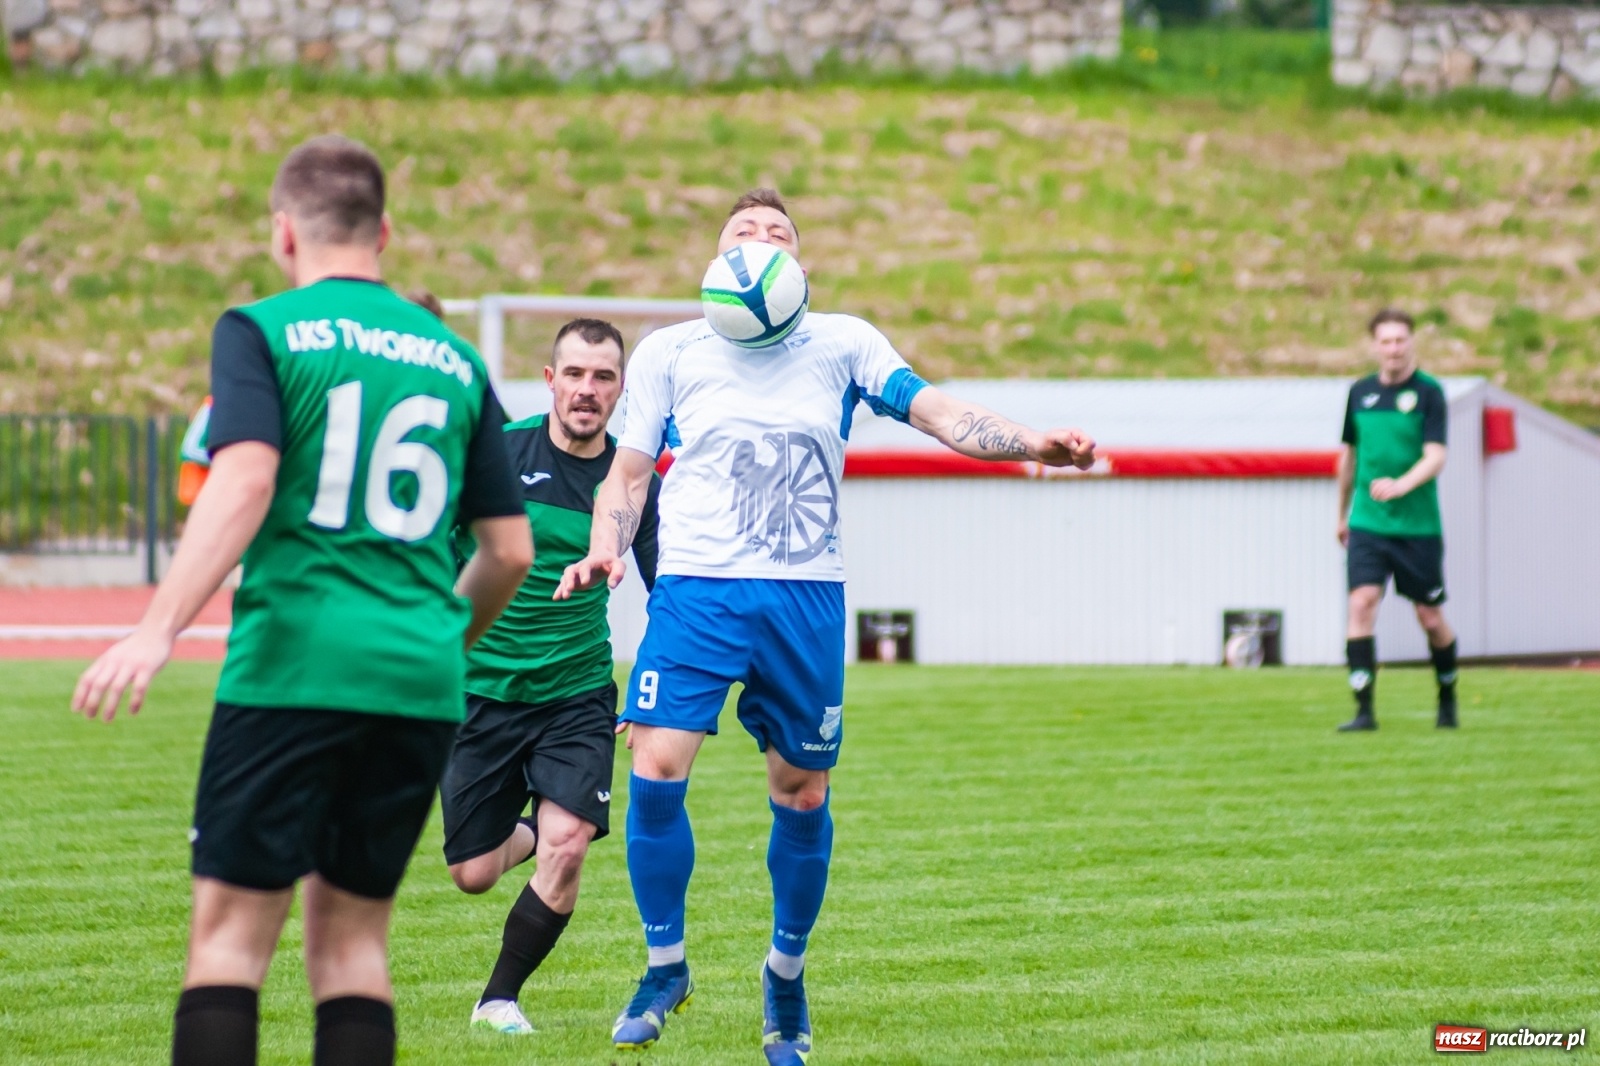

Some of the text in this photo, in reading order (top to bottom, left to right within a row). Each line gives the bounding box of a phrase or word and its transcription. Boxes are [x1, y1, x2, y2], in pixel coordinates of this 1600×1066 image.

[285, 318, 337, 352] LKS
[307, 380, 449, 542] 16
[637, 670, 659, 710] 9
